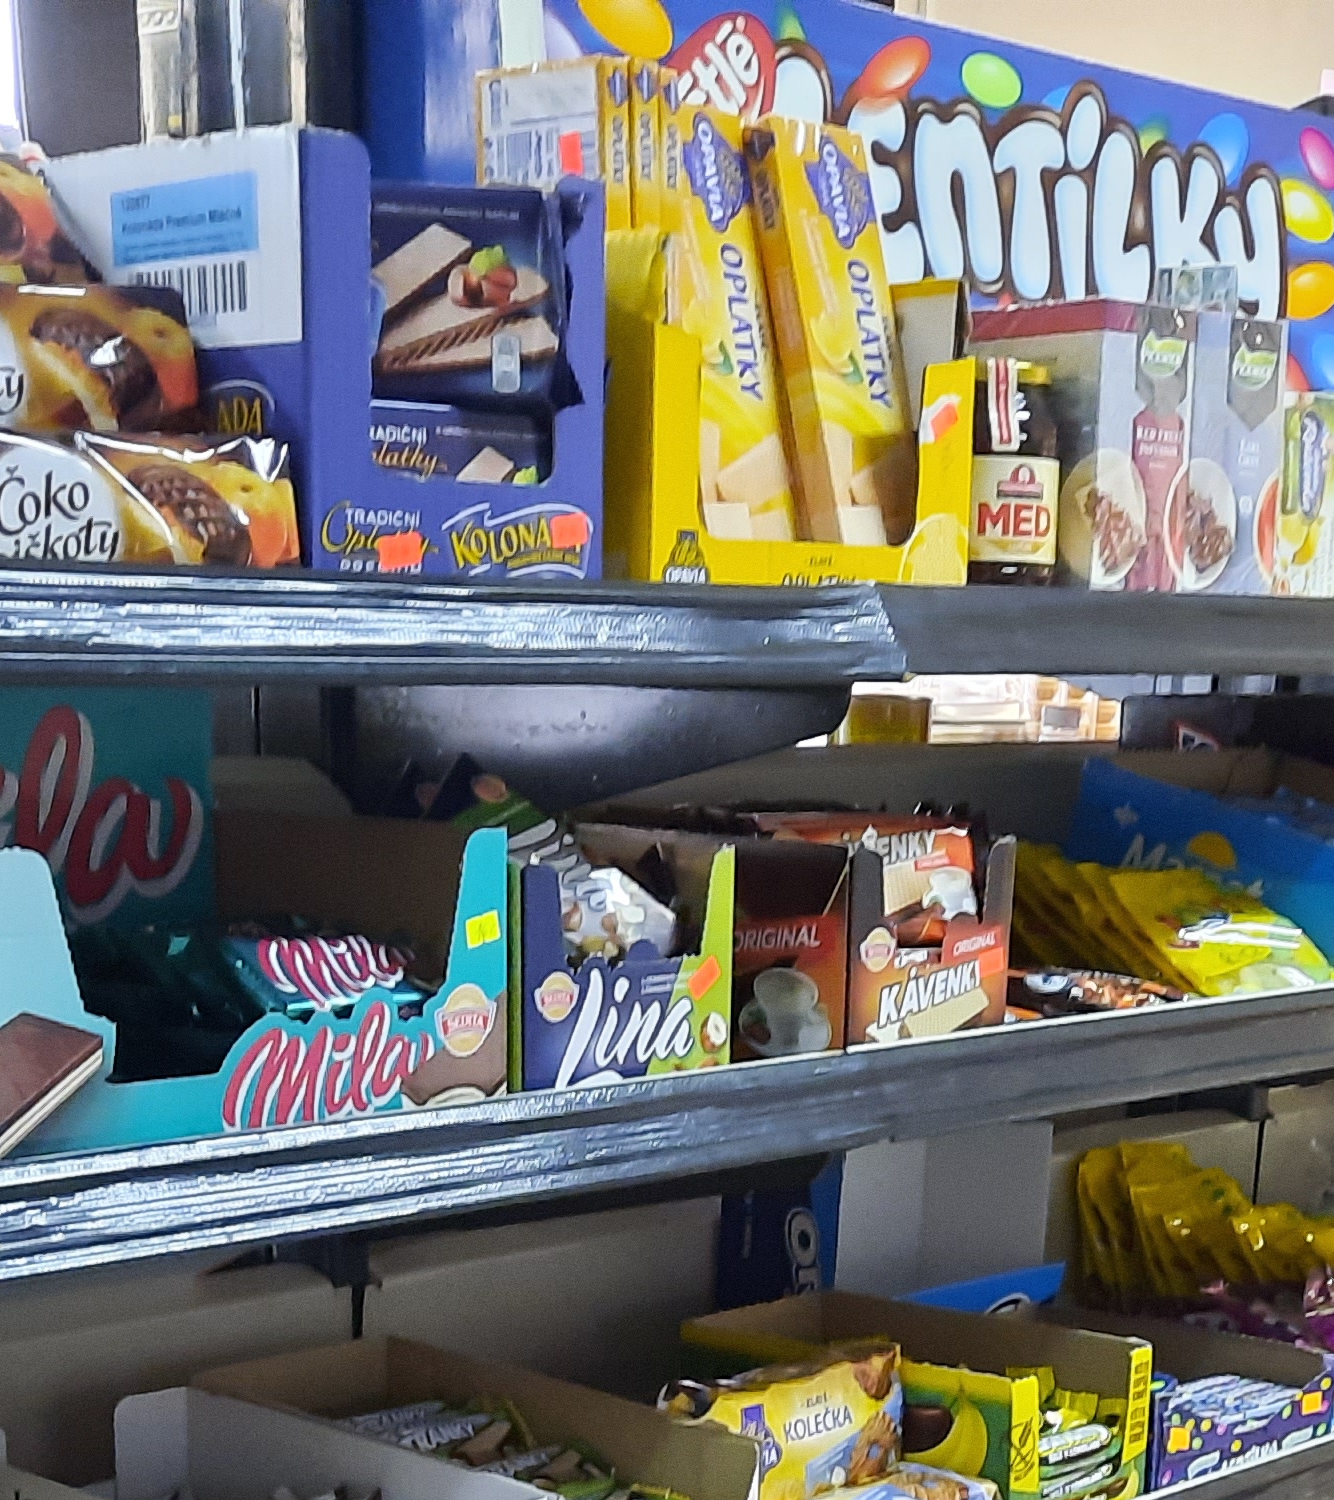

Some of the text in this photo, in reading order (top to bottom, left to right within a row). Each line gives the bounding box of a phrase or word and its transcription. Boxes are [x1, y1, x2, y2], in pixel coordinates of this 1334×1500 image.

[720, 244, 764, 402] OPLATKY
[848, 259, 890, 409] OPLATKY
[452, 516, 581, 569] KOLONA
[977, 502, 1052, 537] MED
[224, 1001, 433, 1133] Mila
[555, 968, 694, 1090] Lina
[783, 1406, 853, 1444] KOLEČKA
